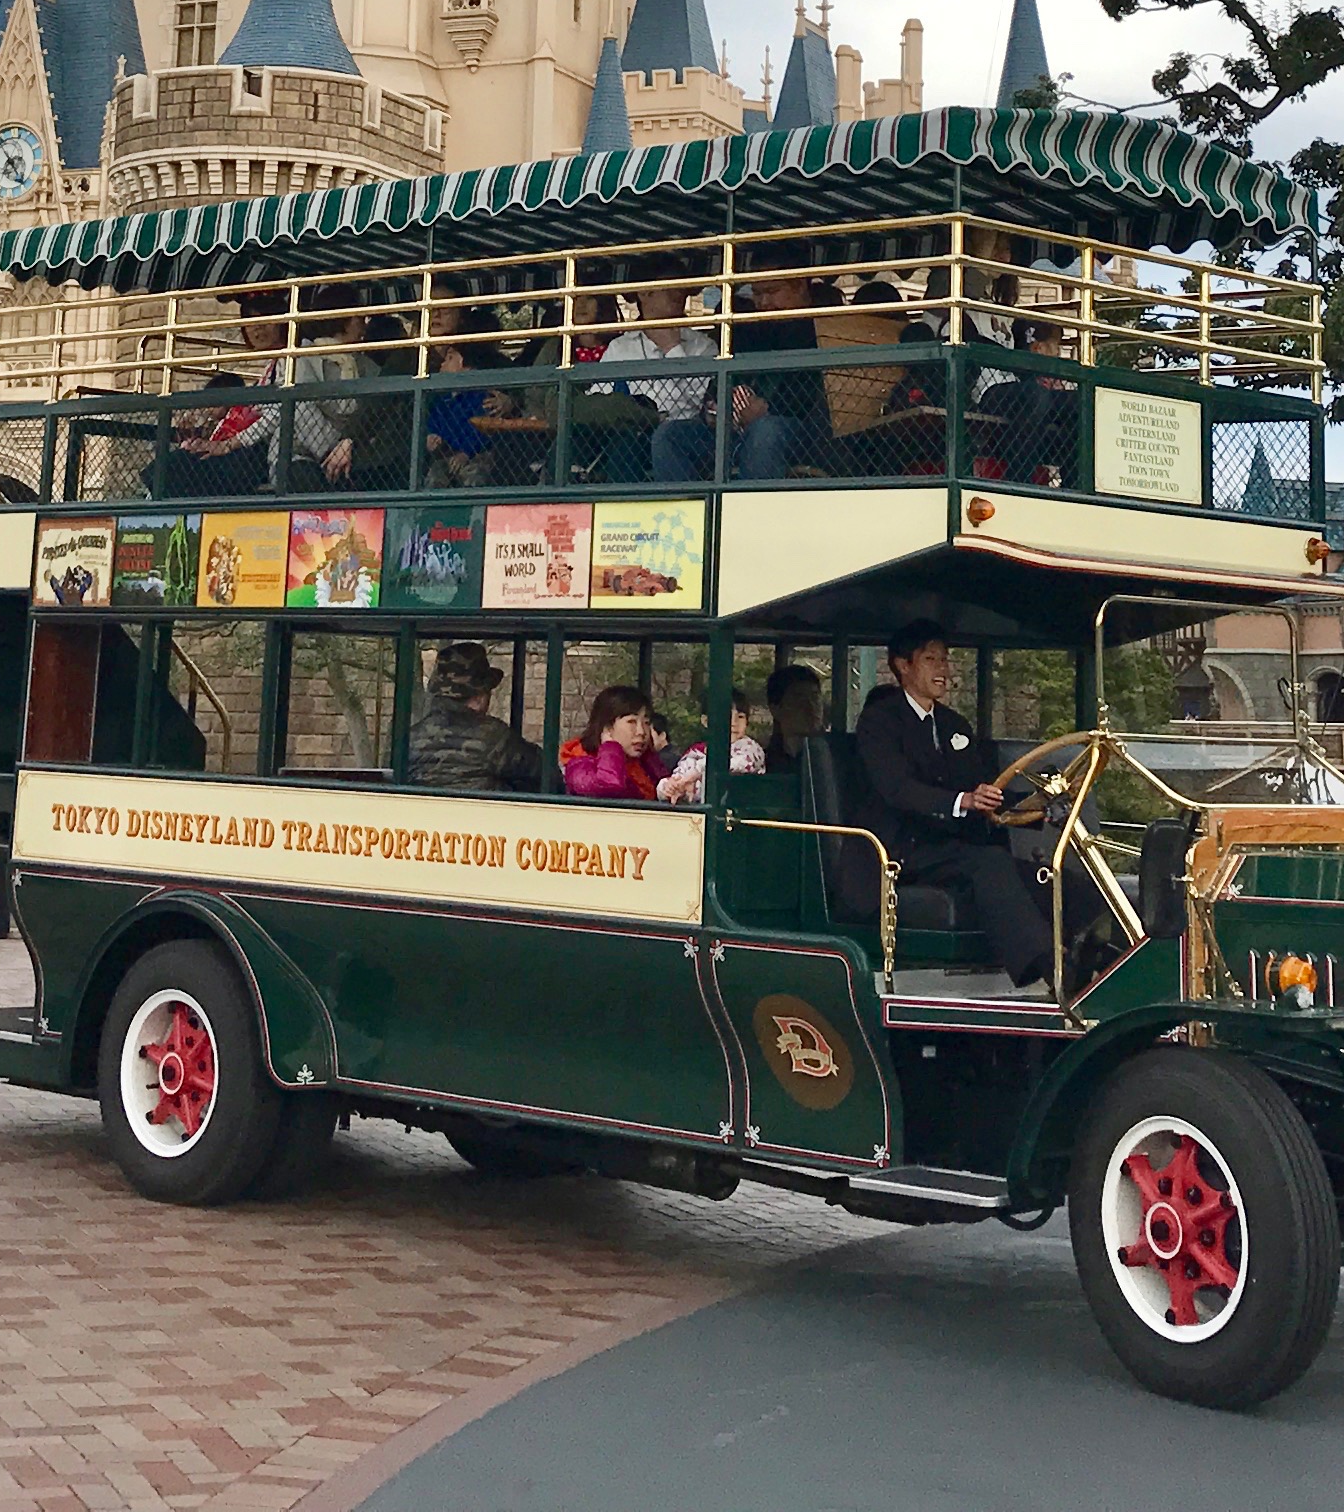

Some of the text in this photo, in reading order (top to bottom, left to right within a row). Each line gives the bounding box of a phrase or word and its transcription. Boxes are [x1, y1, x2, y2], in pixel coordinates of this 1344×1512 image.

[1121, 400, 1176, 417] WORLD BAZAAR
[1118, 413, 1179, 430] ADVENTURELAND
[1122, 426, 1175, 442] WESTERNLAND
[1116, 438, 1180, 455] CRITTER COUNTRY
[1124, 451, 1174, 467] FANTASYLAND
[1128, 465, 1170, 479] TOON TOWN
[1119, 476, 1179, 492] TOMORROWLAND
[600, 533, 628, 541] GRAND
[517, 542, 544, 558] SMALL
[505, 563, 536, 577] WORLD
[52, 803, 650, 880] TOKYO DISNEYLAND TRANSPORTATION COMPANY
